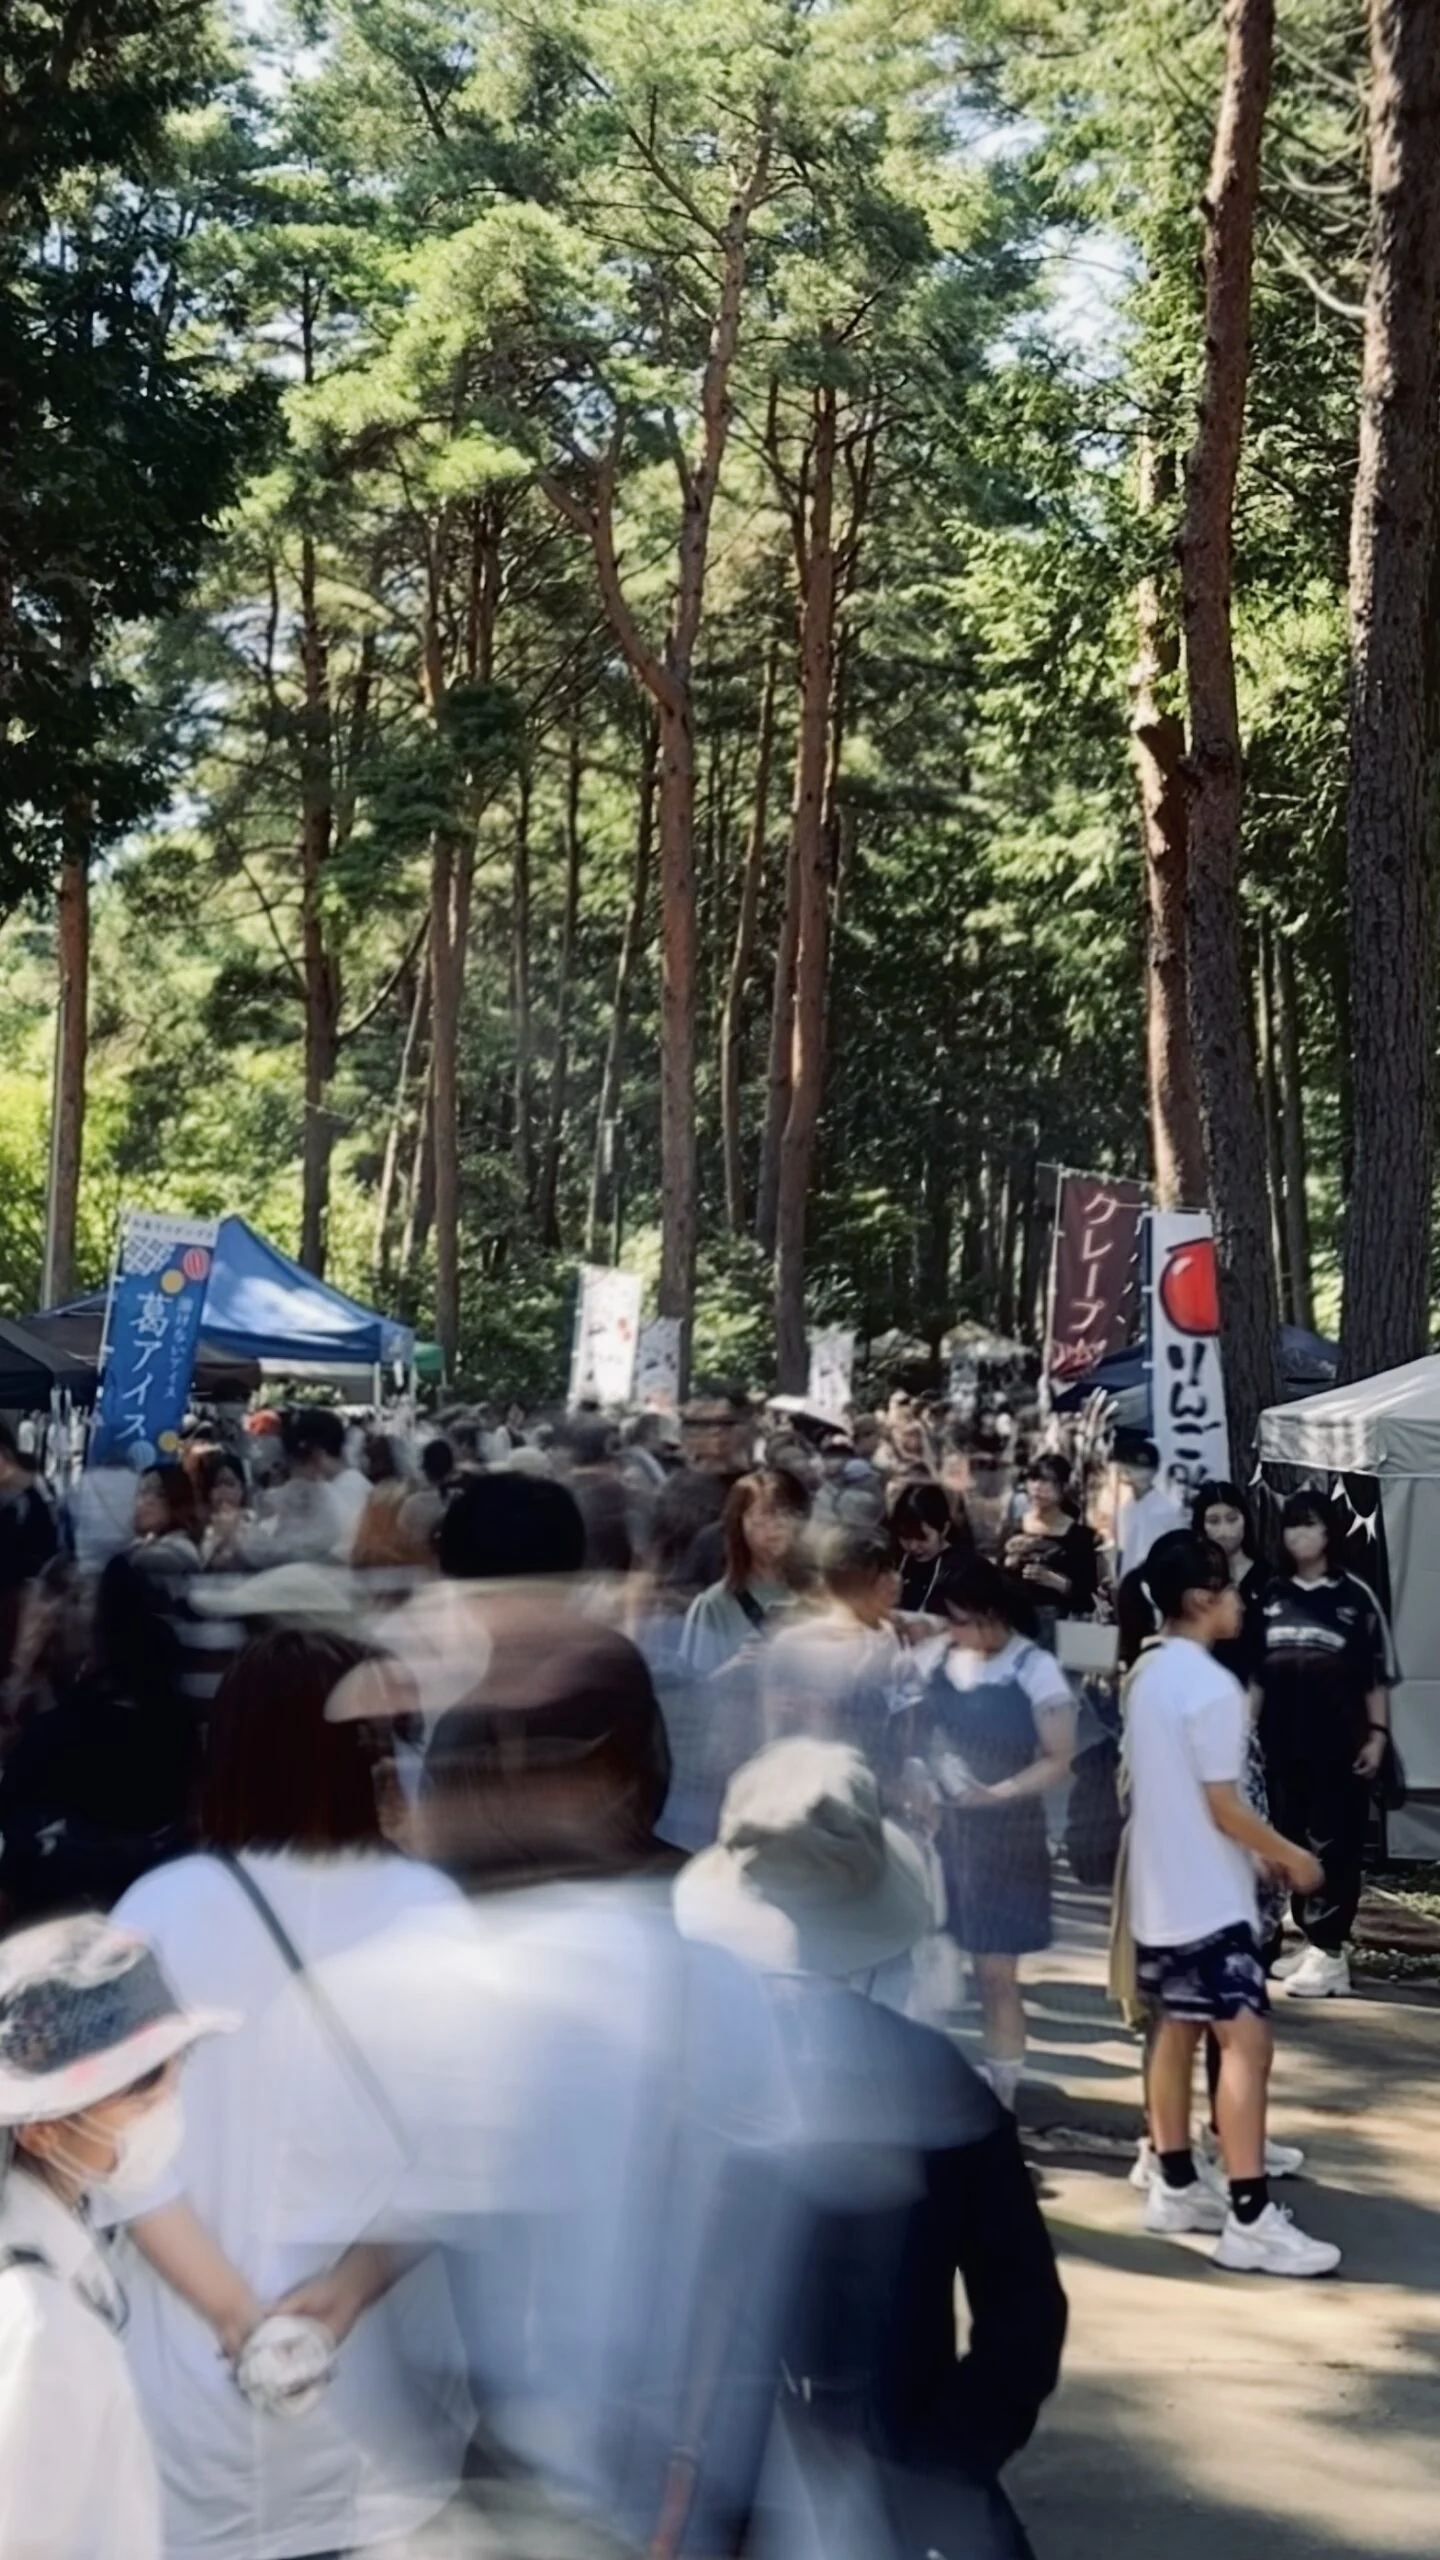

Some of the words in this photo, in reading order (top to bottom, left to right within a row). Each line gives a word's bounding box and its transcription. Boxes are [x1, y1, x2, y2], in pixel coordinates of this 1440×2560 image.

[1068, 1192, 1118, 1335] クレープ
[115, 1290, 172, 1440] 葛アイス
